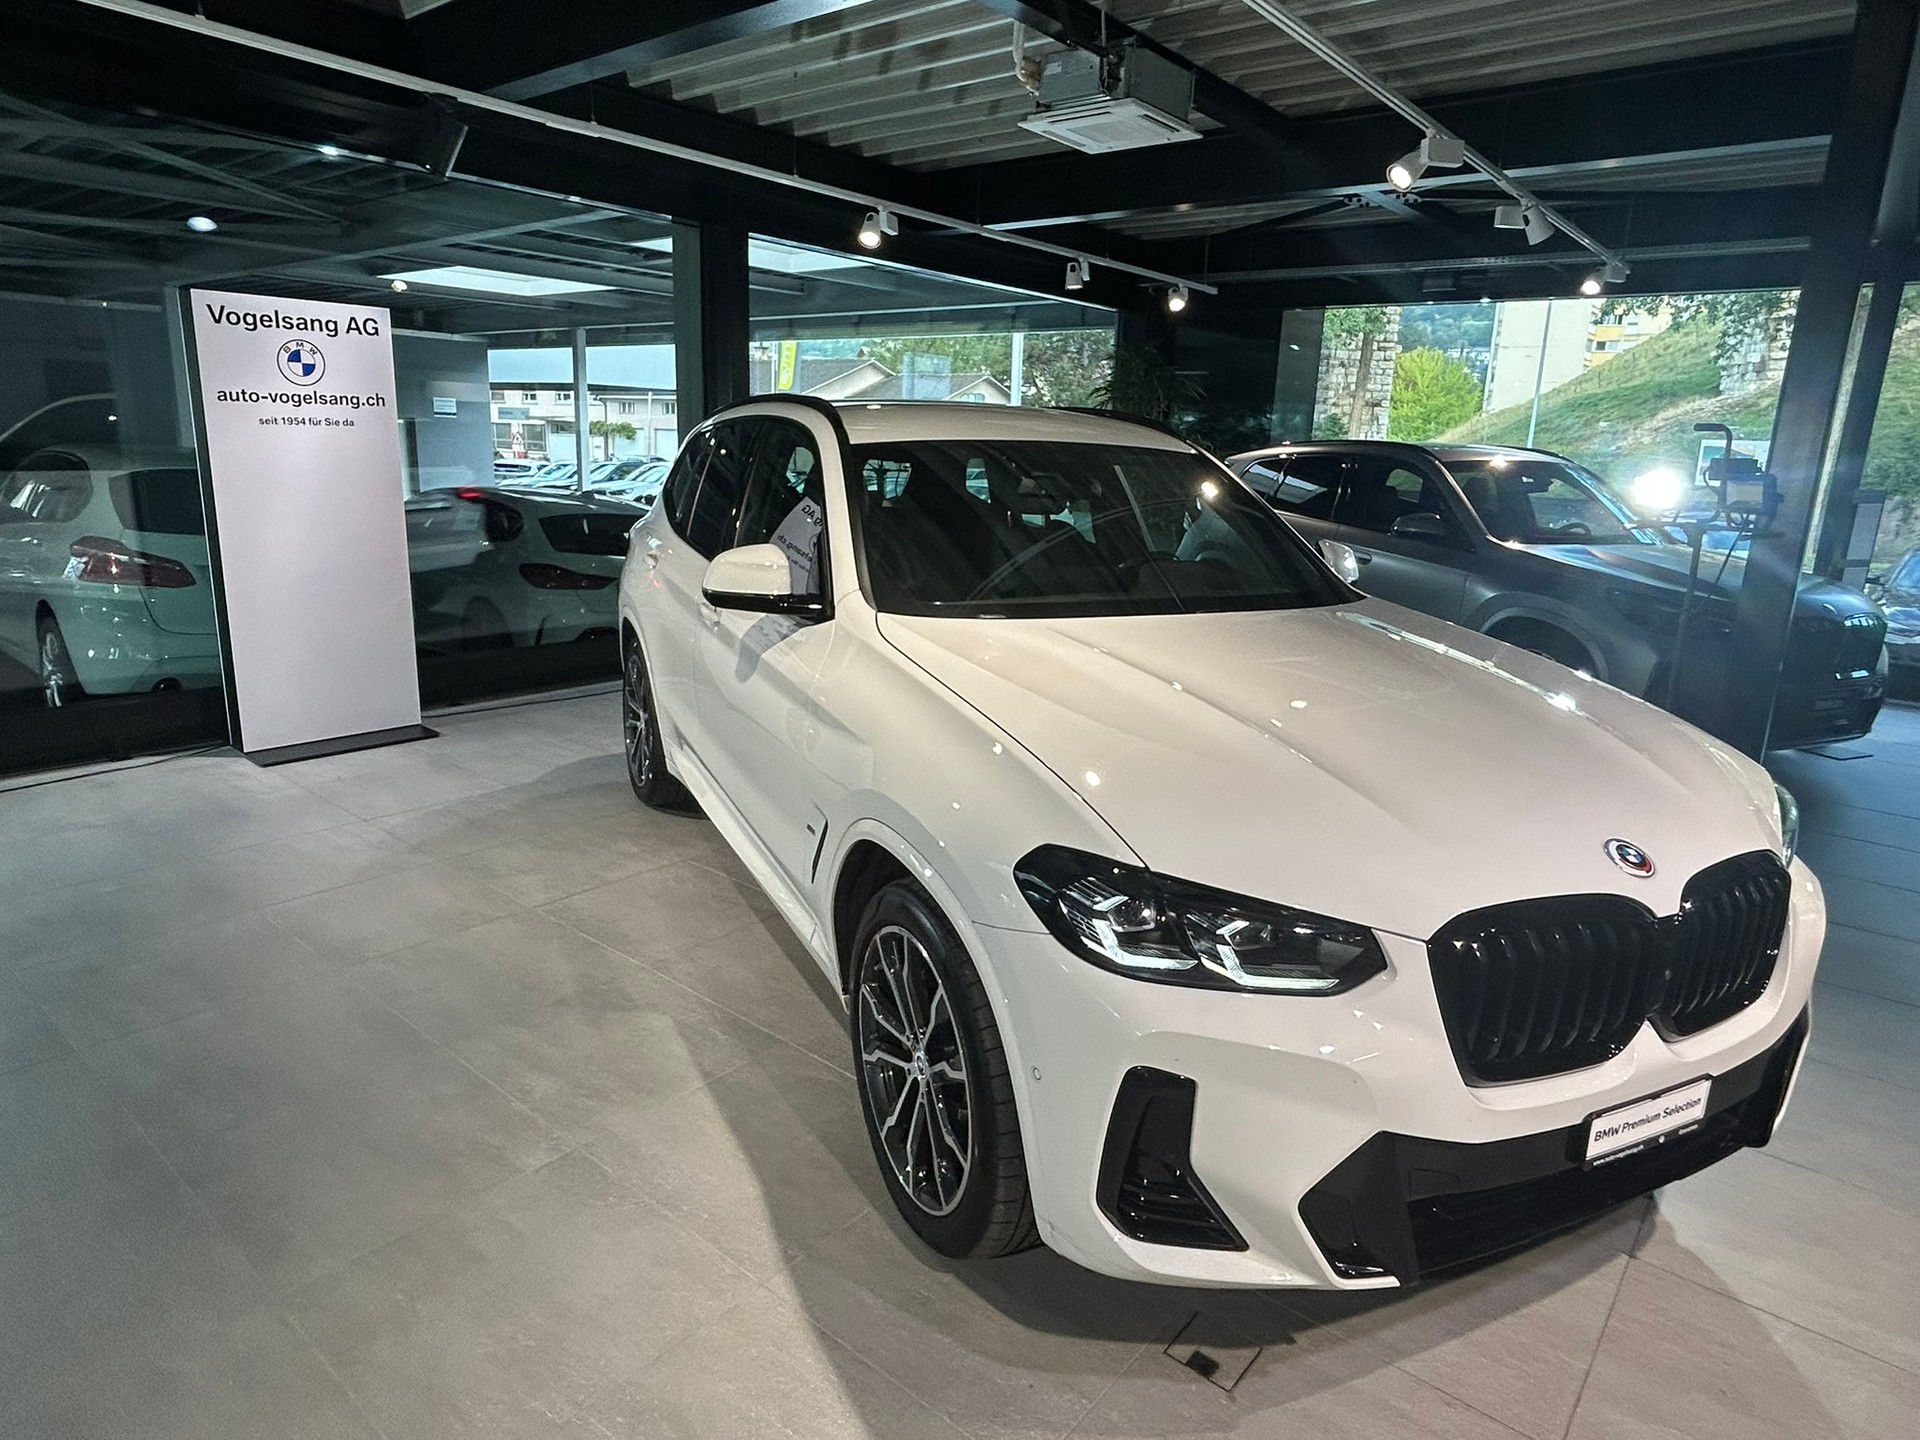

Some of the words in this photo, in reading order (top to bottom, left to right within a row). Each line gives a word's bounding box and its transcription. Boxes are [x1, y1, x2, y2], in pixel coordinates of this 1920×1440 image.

[206, 303, 339, 338] Vogelsang
[346, 316, 380, 337] AG
[283, 341, 318, 356] BMW
[216, 388, 386, 409] auto-vogelsang.ch
[258, 416, 279, 425] seit
[281, 416, 306, 426] 1954
[308, 417, 322, 426] für
[324, 417, 340, 427] Sie
[342, 418, 355, 427] da
[1594, 1124, 1621, 1142] BMW
[1621, 1112, 1661, 1133] Premium
[1662, 1097, 1702, 1119] Selection
